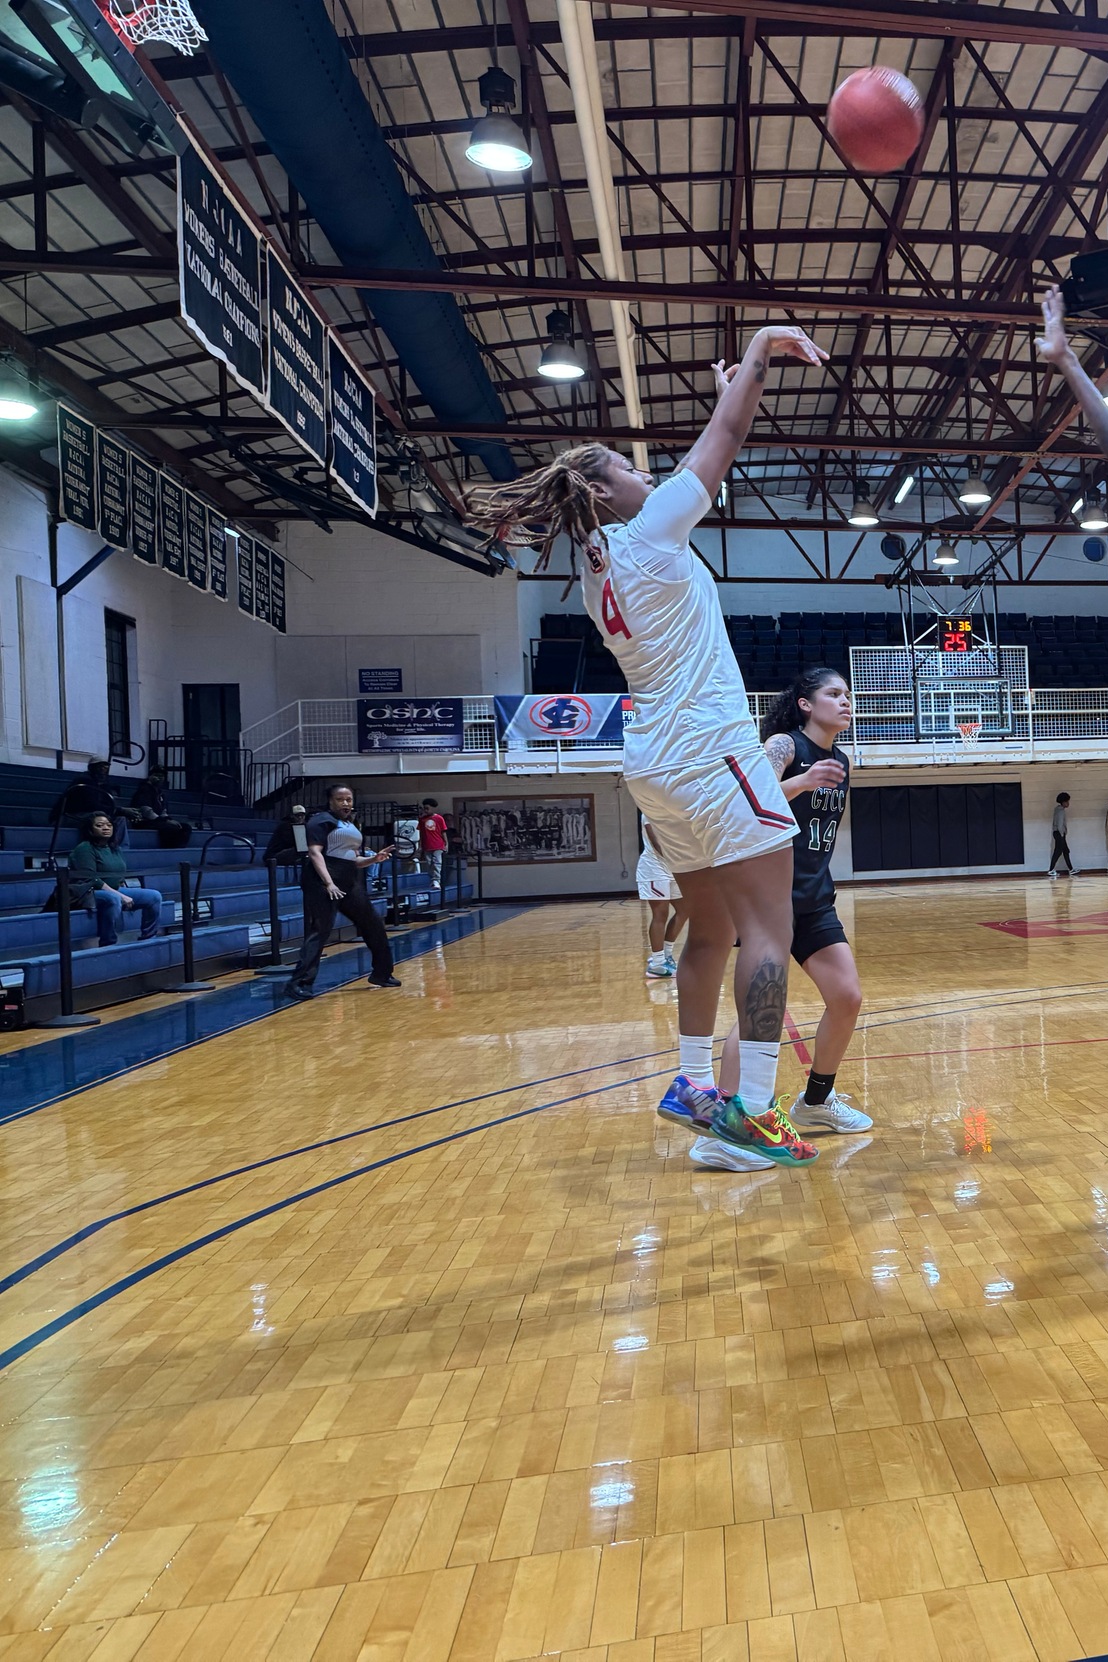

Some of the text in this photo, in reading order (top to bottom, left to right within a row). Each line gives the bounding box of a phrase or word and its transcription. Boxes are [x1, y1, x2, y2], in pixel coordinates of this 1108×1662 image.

[185, 240, 261, 349] NATIONAL CHAMPIONS
[219, 248, 259, 312] BASKETBALL
[273, 346, 298, 394] NATIONAL
[602, 577, 633, 640] 4
[944, 633, 967, 652] 25
[811, 787, 844, 812] GTCC
[808, 817, 837, 852] 14
